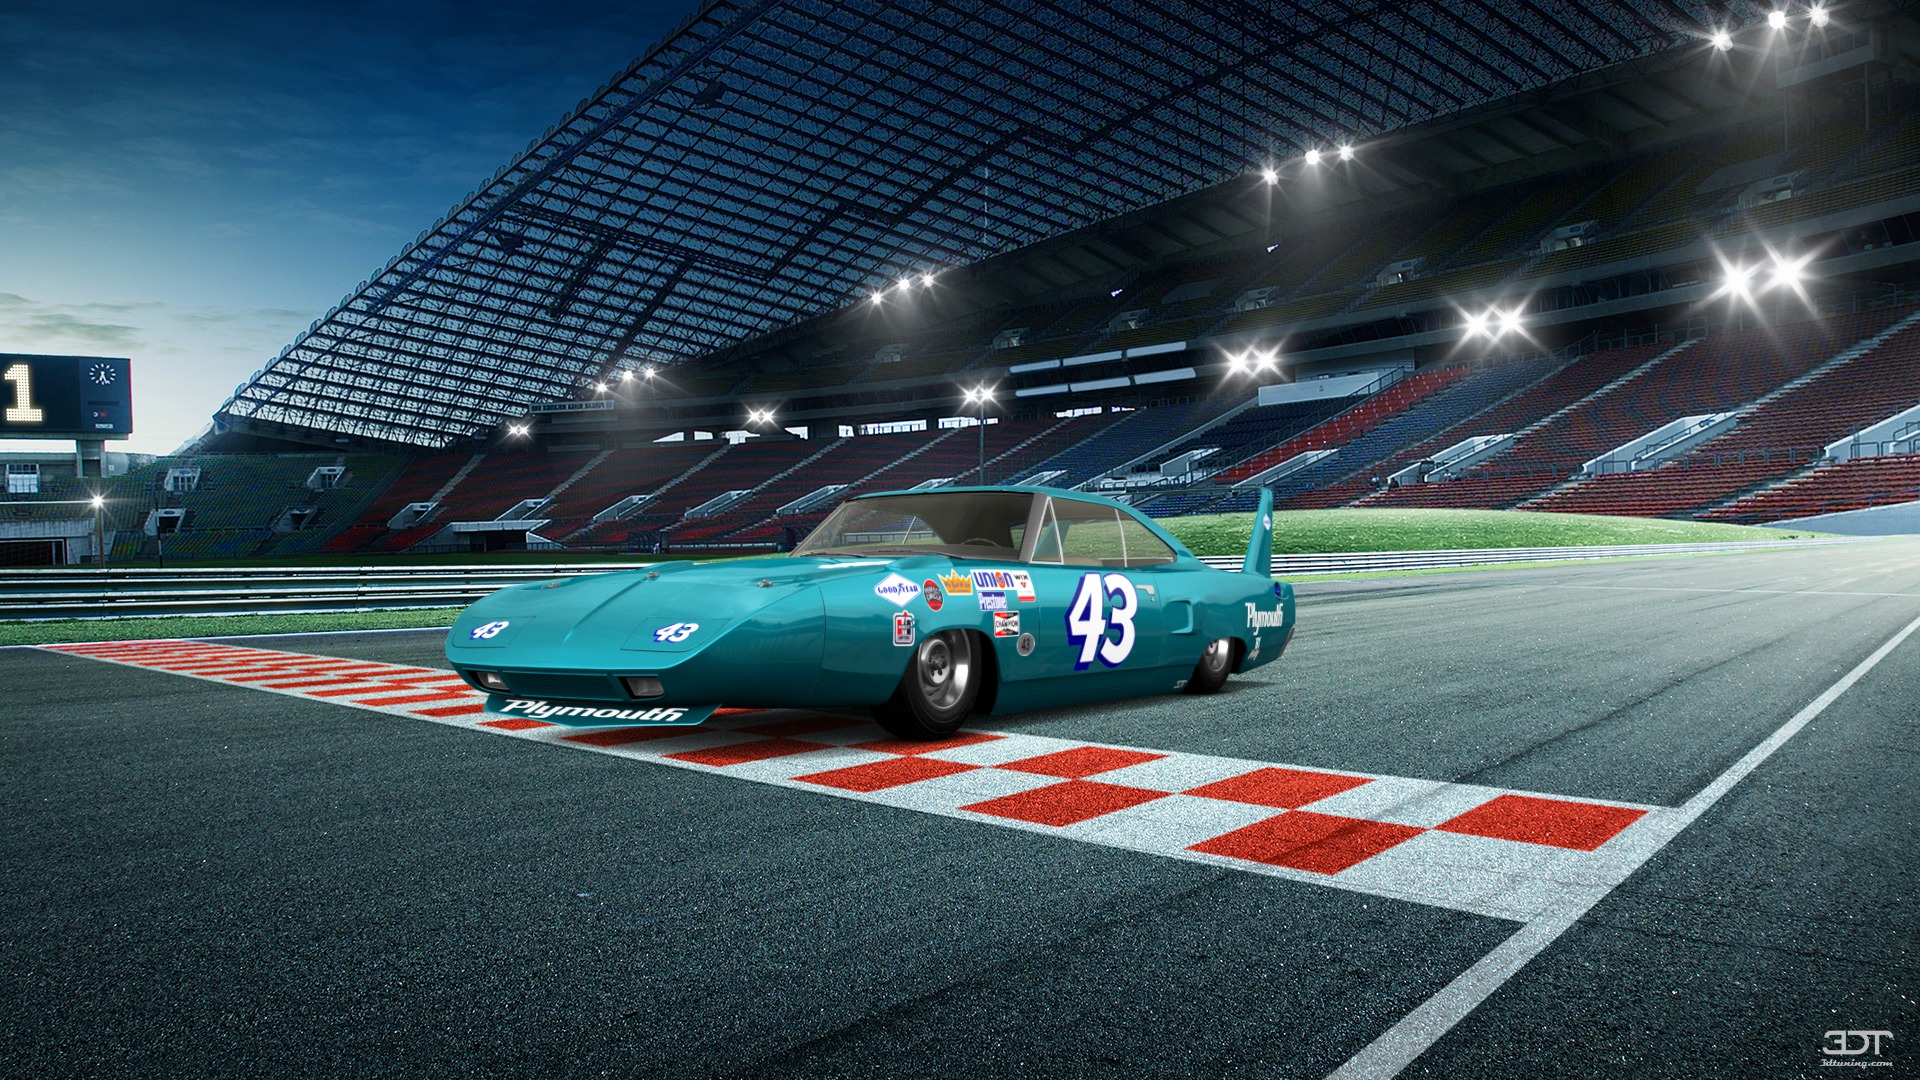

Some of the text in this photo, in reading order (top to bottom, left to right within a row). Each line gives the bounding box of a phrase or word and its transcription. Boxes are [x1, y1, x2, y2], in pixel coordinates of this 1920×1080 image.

[4, 364, 42, 422] 1
[973, 572, 1014, 588] UNION
[979, 593, 1007, 610] Prestone
[996, 619, 1018, 628] CHAMPION
[1065, 572, 1138, 671] 43
[1245, 602, 1283, 635] Plymouth
[469, 621, 509, 640] 43
[653, 623, 699, 643] 43
[1021, 638, 1030, 651] 43
[500, 699, 689, 722] Plymouth
